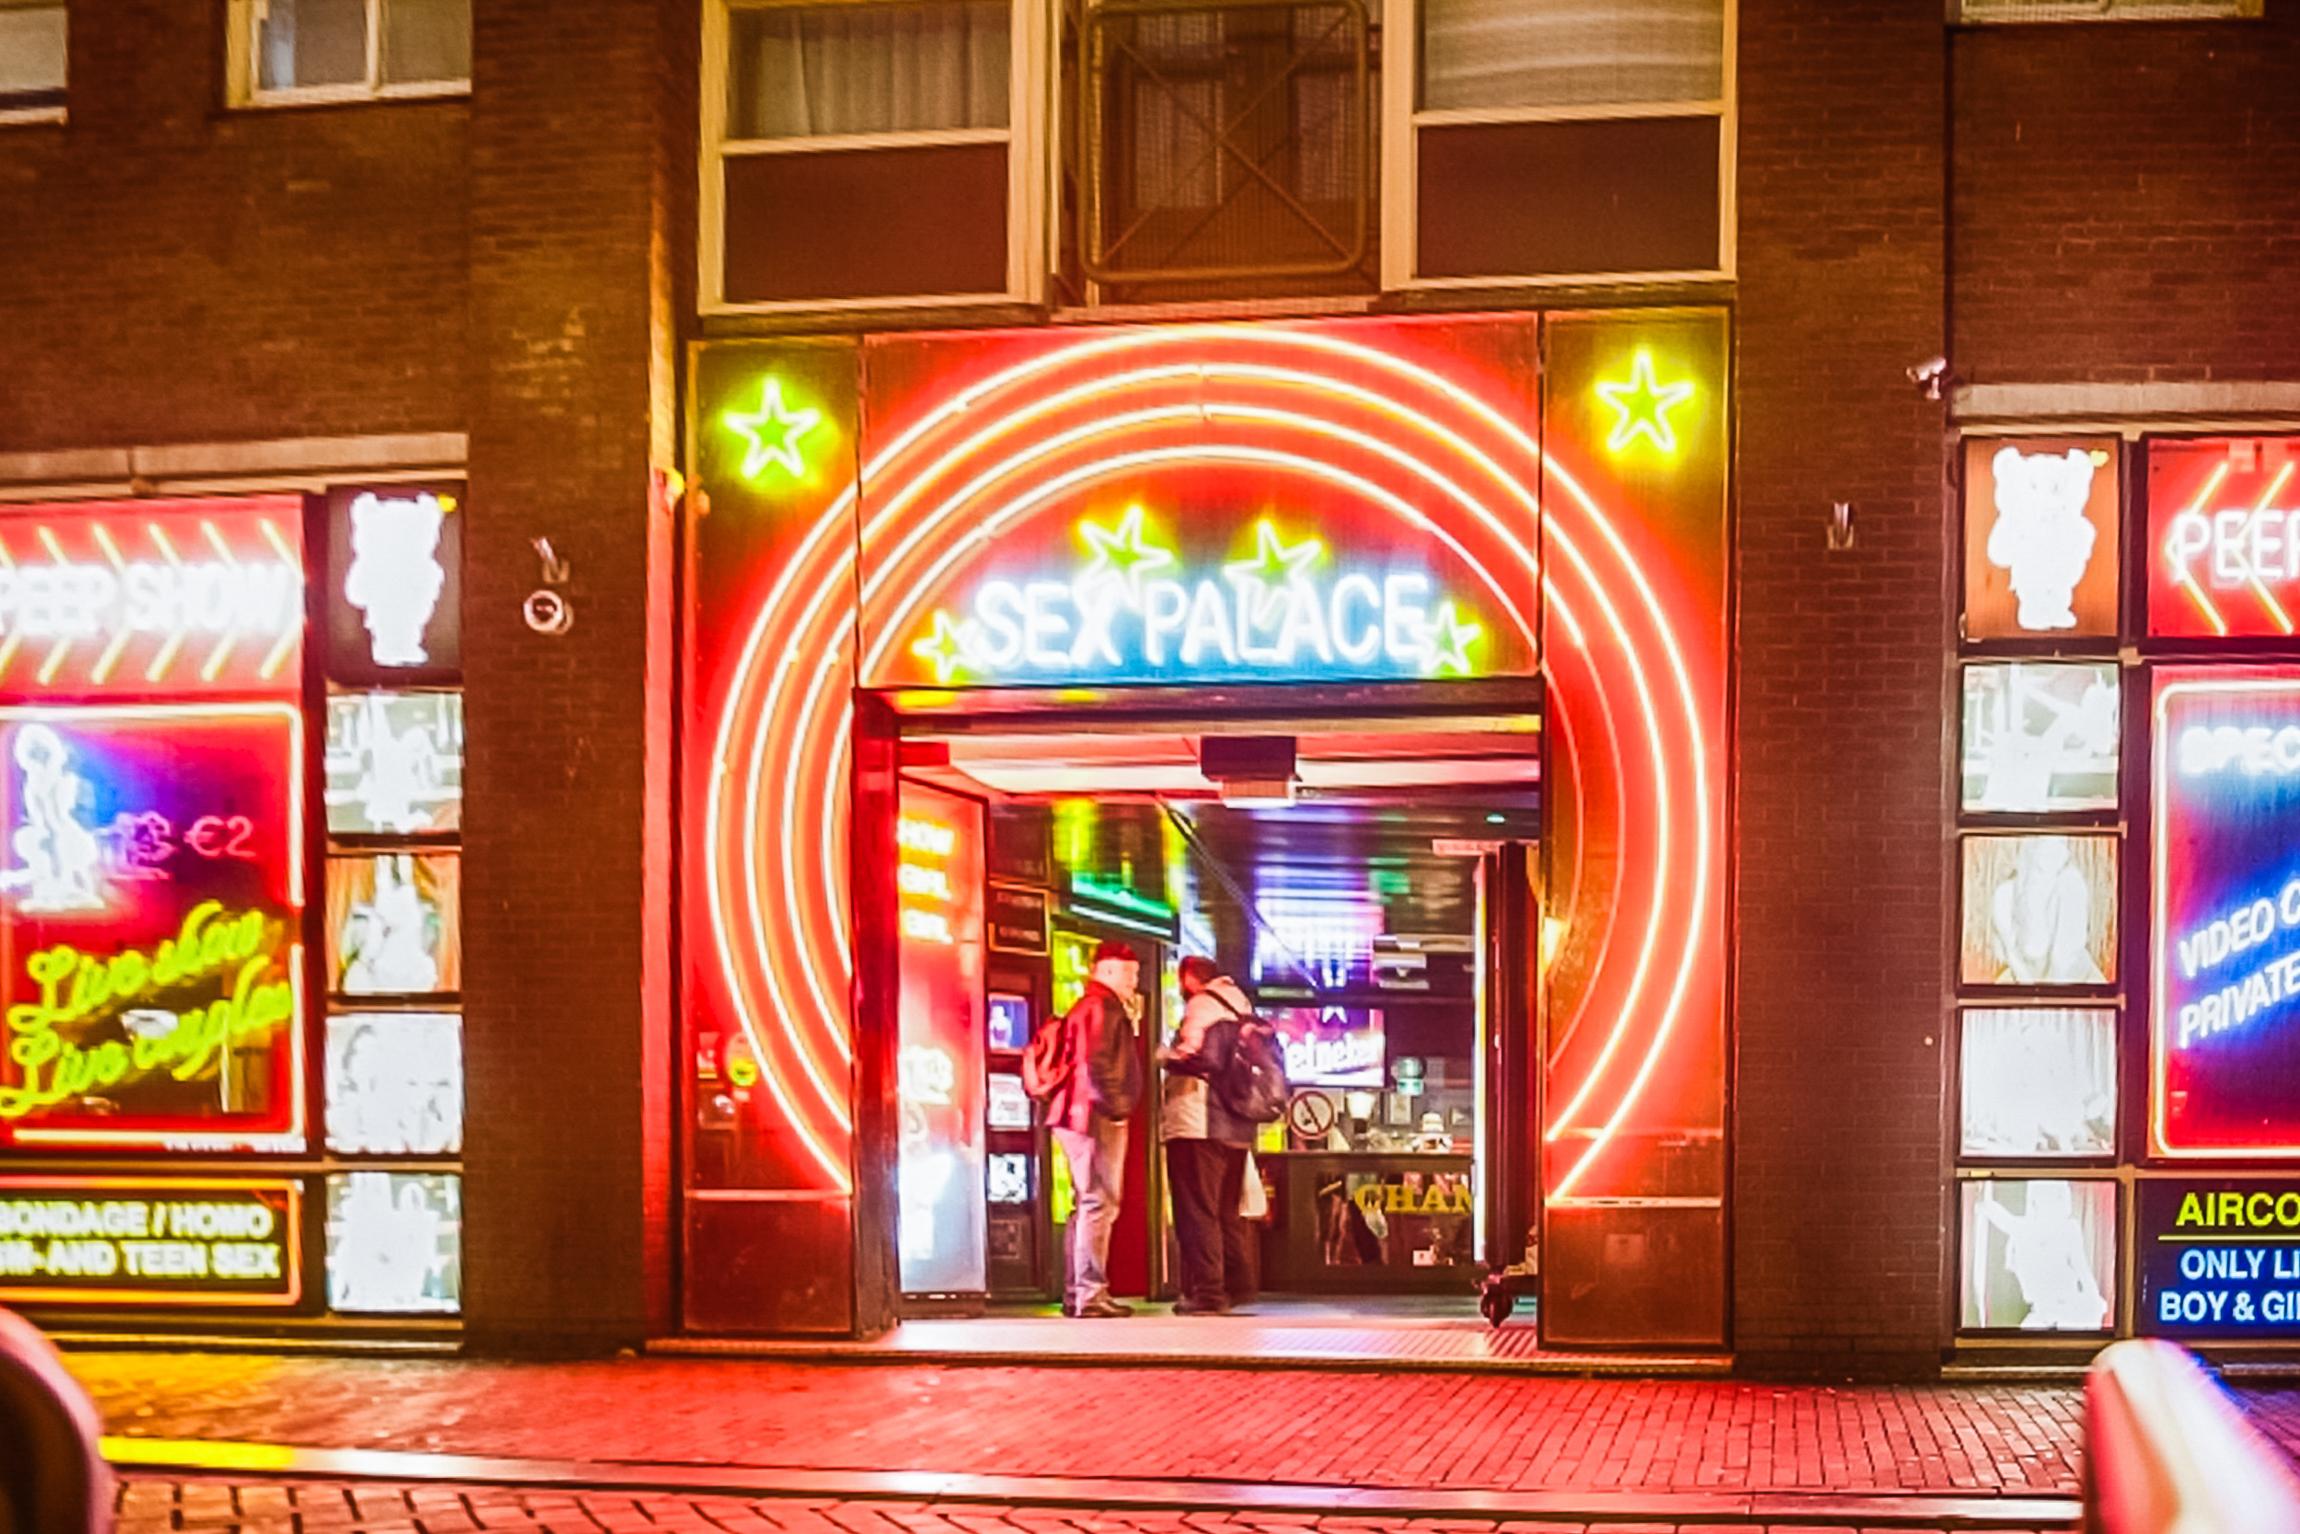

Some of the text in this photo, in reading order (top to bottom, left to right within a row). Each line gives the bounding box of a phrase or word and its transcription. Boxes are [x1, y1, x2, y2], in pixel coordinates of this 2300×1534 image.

[124, 562, 291, 632] SHOW
[974, 573, 1430, 668] SEX PALACE
[2180, 897, 2276, 978] VIDEO
[7, 945, 149, 1033] Live
[0, 1028, 130, 1117] Live
[169, 1202, 274, 1239] HOMO
[2176, 1192, 2300, 1228] AIRCO
[119, 1240, 208, 1277] TEEN
[211, 1242, 281, 1279] SEX
[2180, 1249, 2266, 1280] ONLY
[2160, 1290, 2229, 1321] BOY
[2232, 1291, 2255, 1321] &
